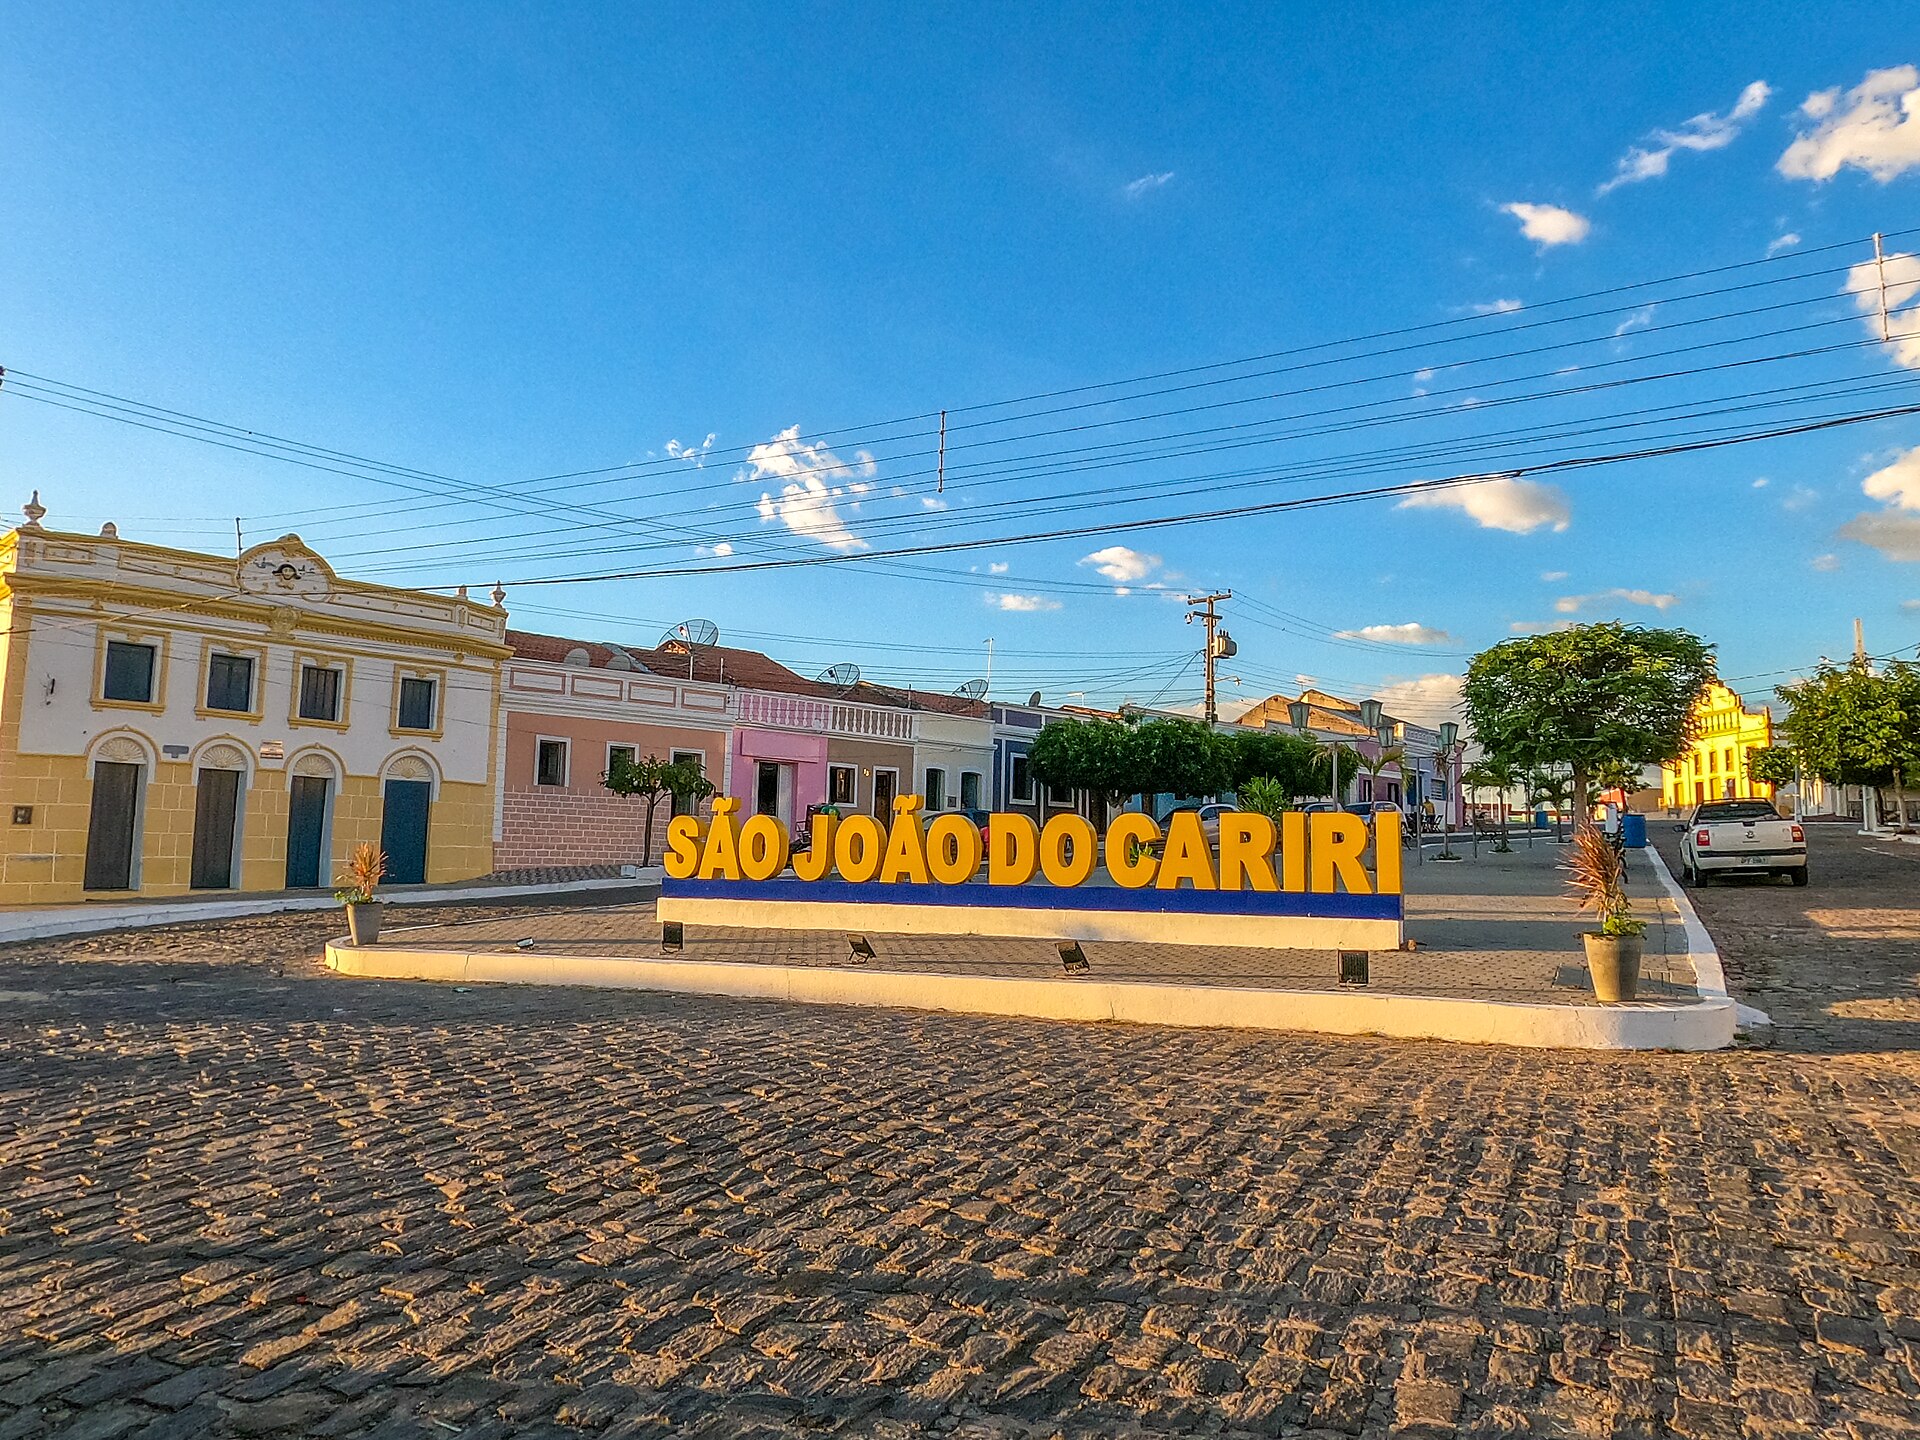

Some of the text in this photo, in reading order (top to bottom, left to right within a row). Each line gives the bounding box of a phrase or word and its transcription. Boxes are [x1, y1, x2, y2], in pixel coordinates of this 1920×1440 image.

[663, 794, 1402, 894] SÃO JOÃO DO CARIRI
